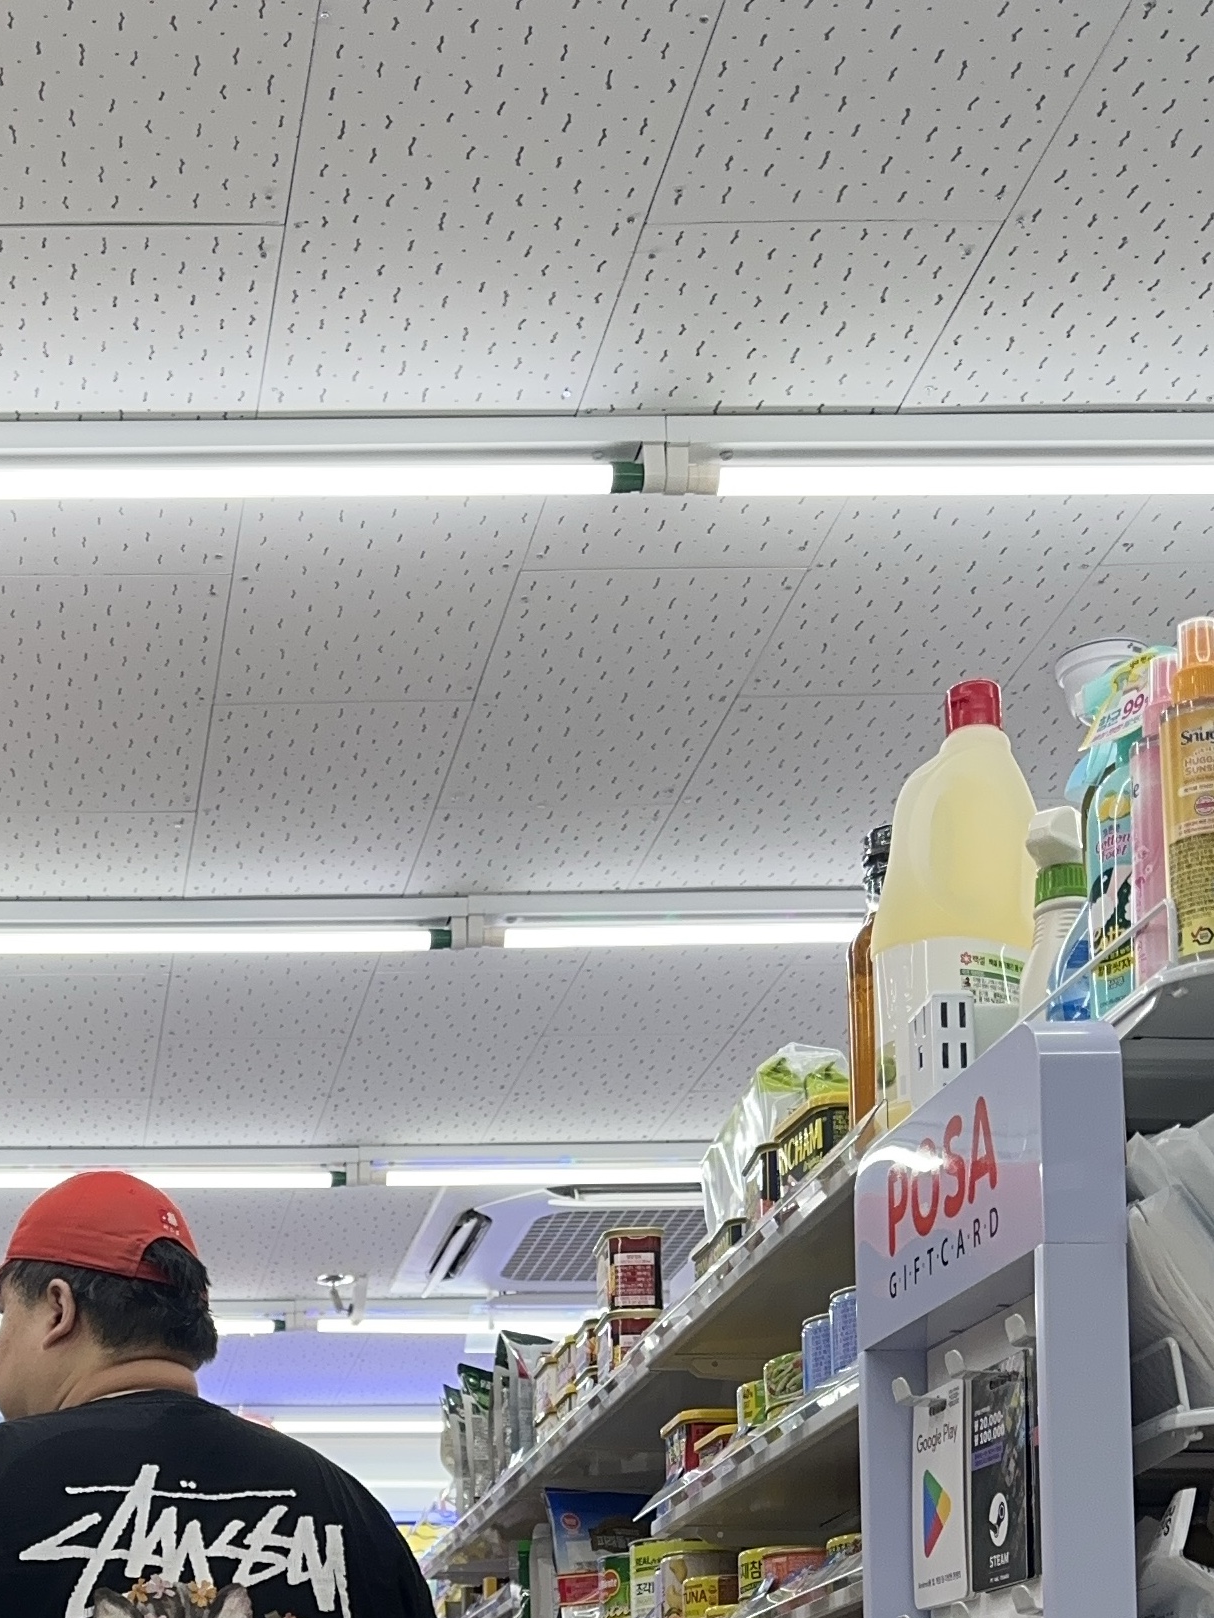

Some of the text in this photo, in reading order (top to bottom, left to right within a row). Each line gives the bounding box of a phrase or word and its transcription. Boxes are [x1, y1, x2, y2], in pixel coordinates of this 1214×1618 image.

[887, 1096, 998, 1258] POSA
[916, 1422, 958, 1454] Google Play
[989, 1551, 1010, 1569] STEAM
